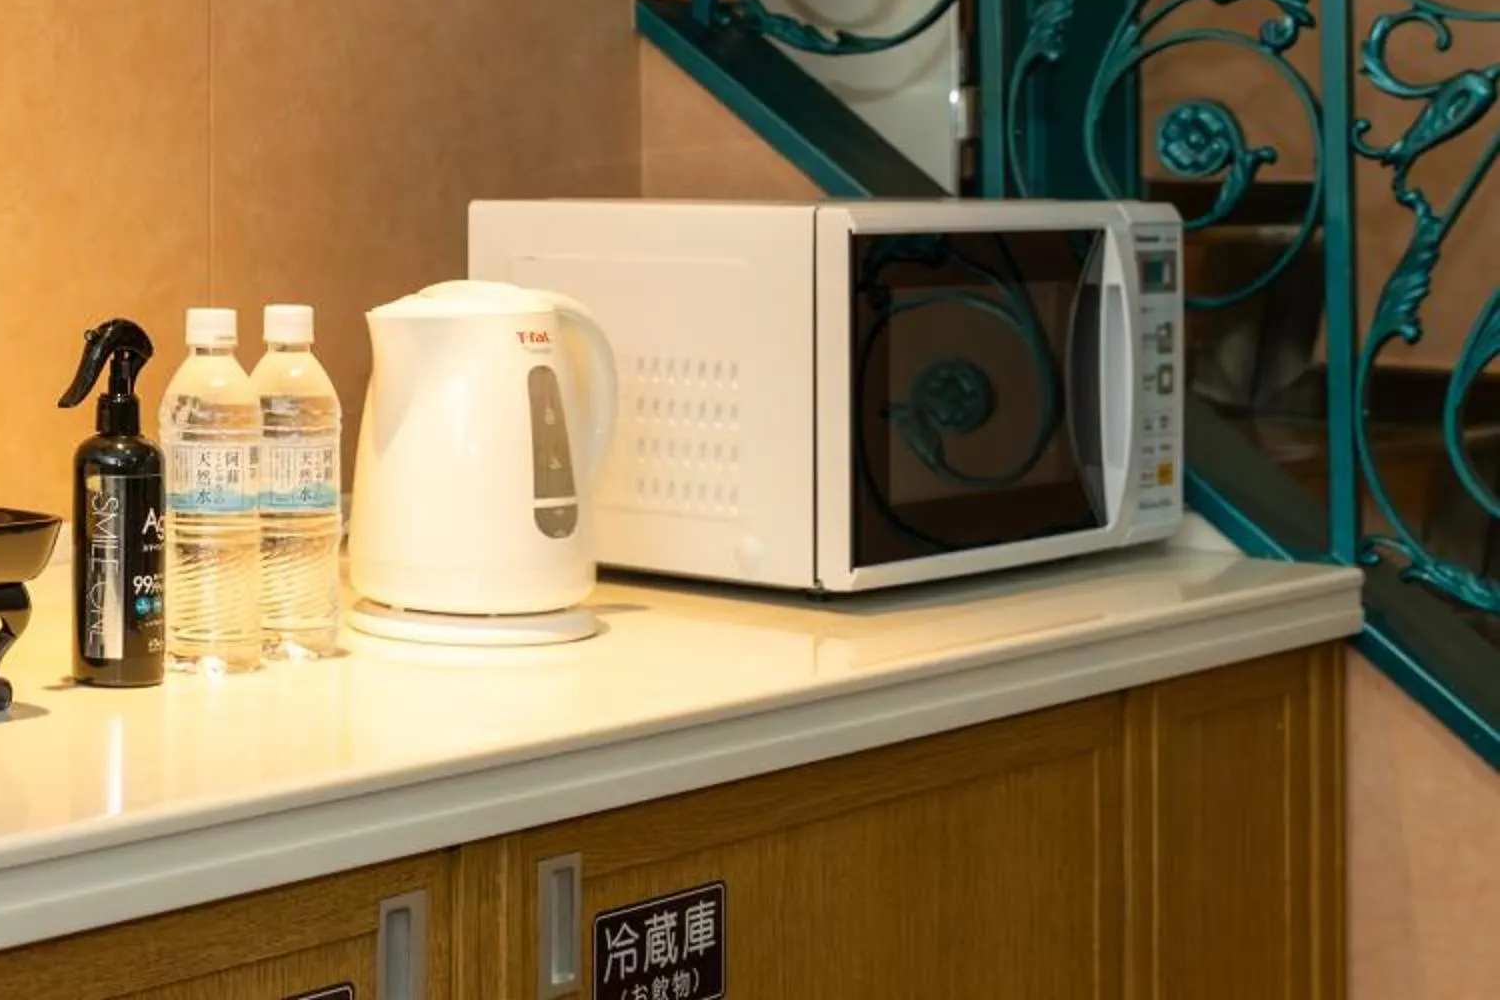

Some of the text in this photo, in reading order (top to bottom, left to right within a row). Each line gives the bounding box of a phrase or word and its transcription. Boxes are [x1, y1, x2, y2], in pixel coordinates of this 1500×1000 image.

[91, 495, 119, 575] SMILE
[603, 899, 717, 984] 冷蔵庫
